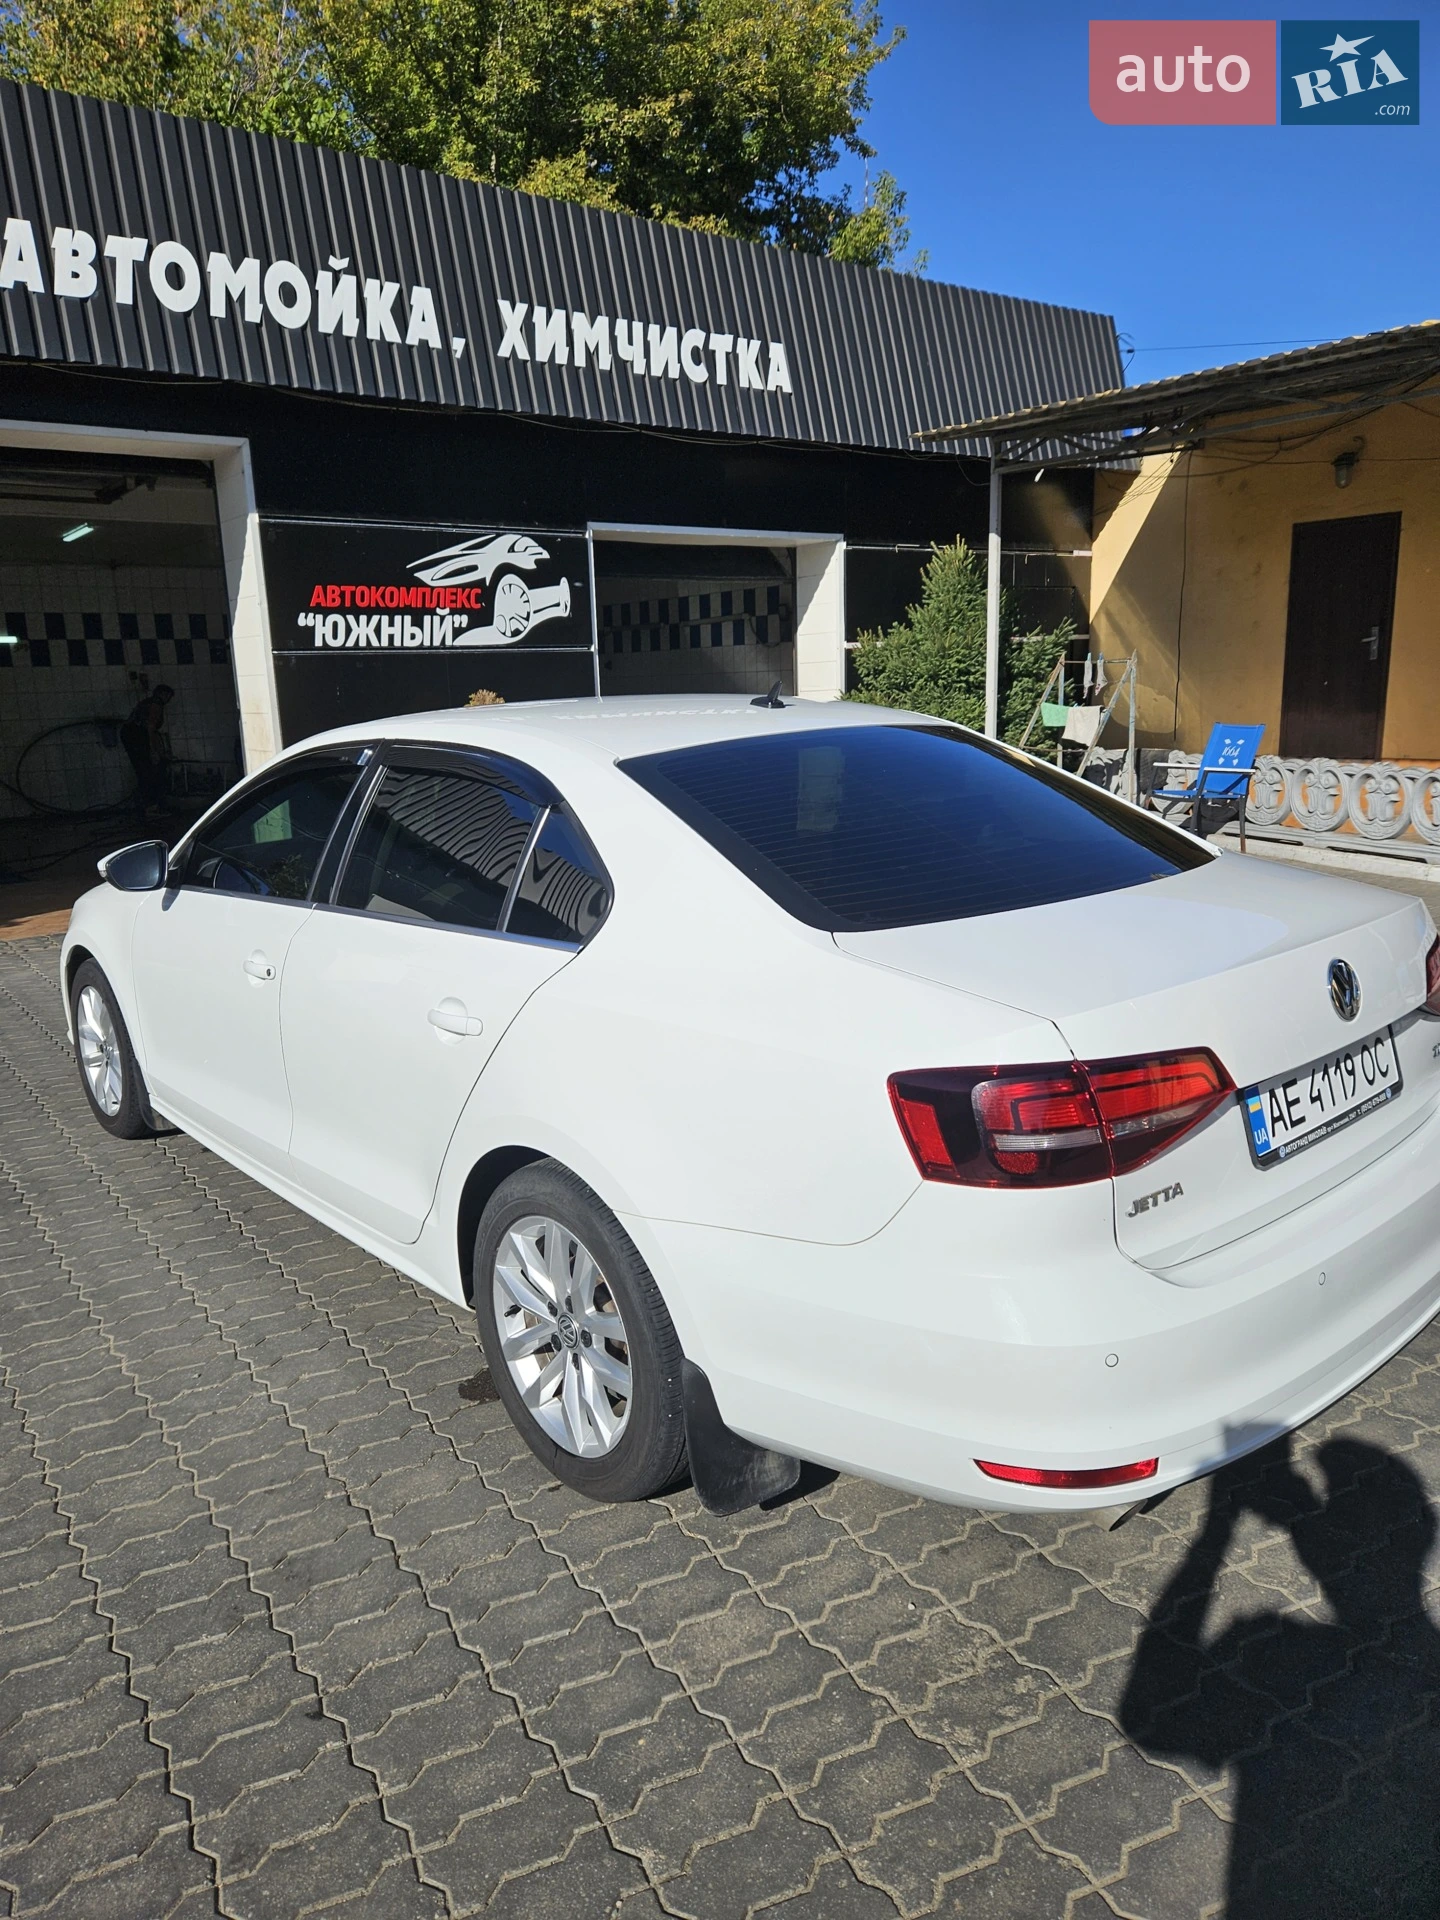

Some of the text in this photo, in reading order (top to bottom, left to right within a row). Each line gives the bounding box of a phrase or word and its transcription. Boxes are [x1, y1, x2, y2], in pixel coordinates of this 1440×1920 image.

[0, 217, 792, 393] АВТОМОЙКА, ХИМЧИСТКА
[310, 585, 482, 609] АВТОКОМПЛЕКС
[1268, 1037, 1389, 1137] AE 4119 OC
[1254, 1127, 1269, 1145] UA
[1125, 1182, 1184, 1217] JETTA
